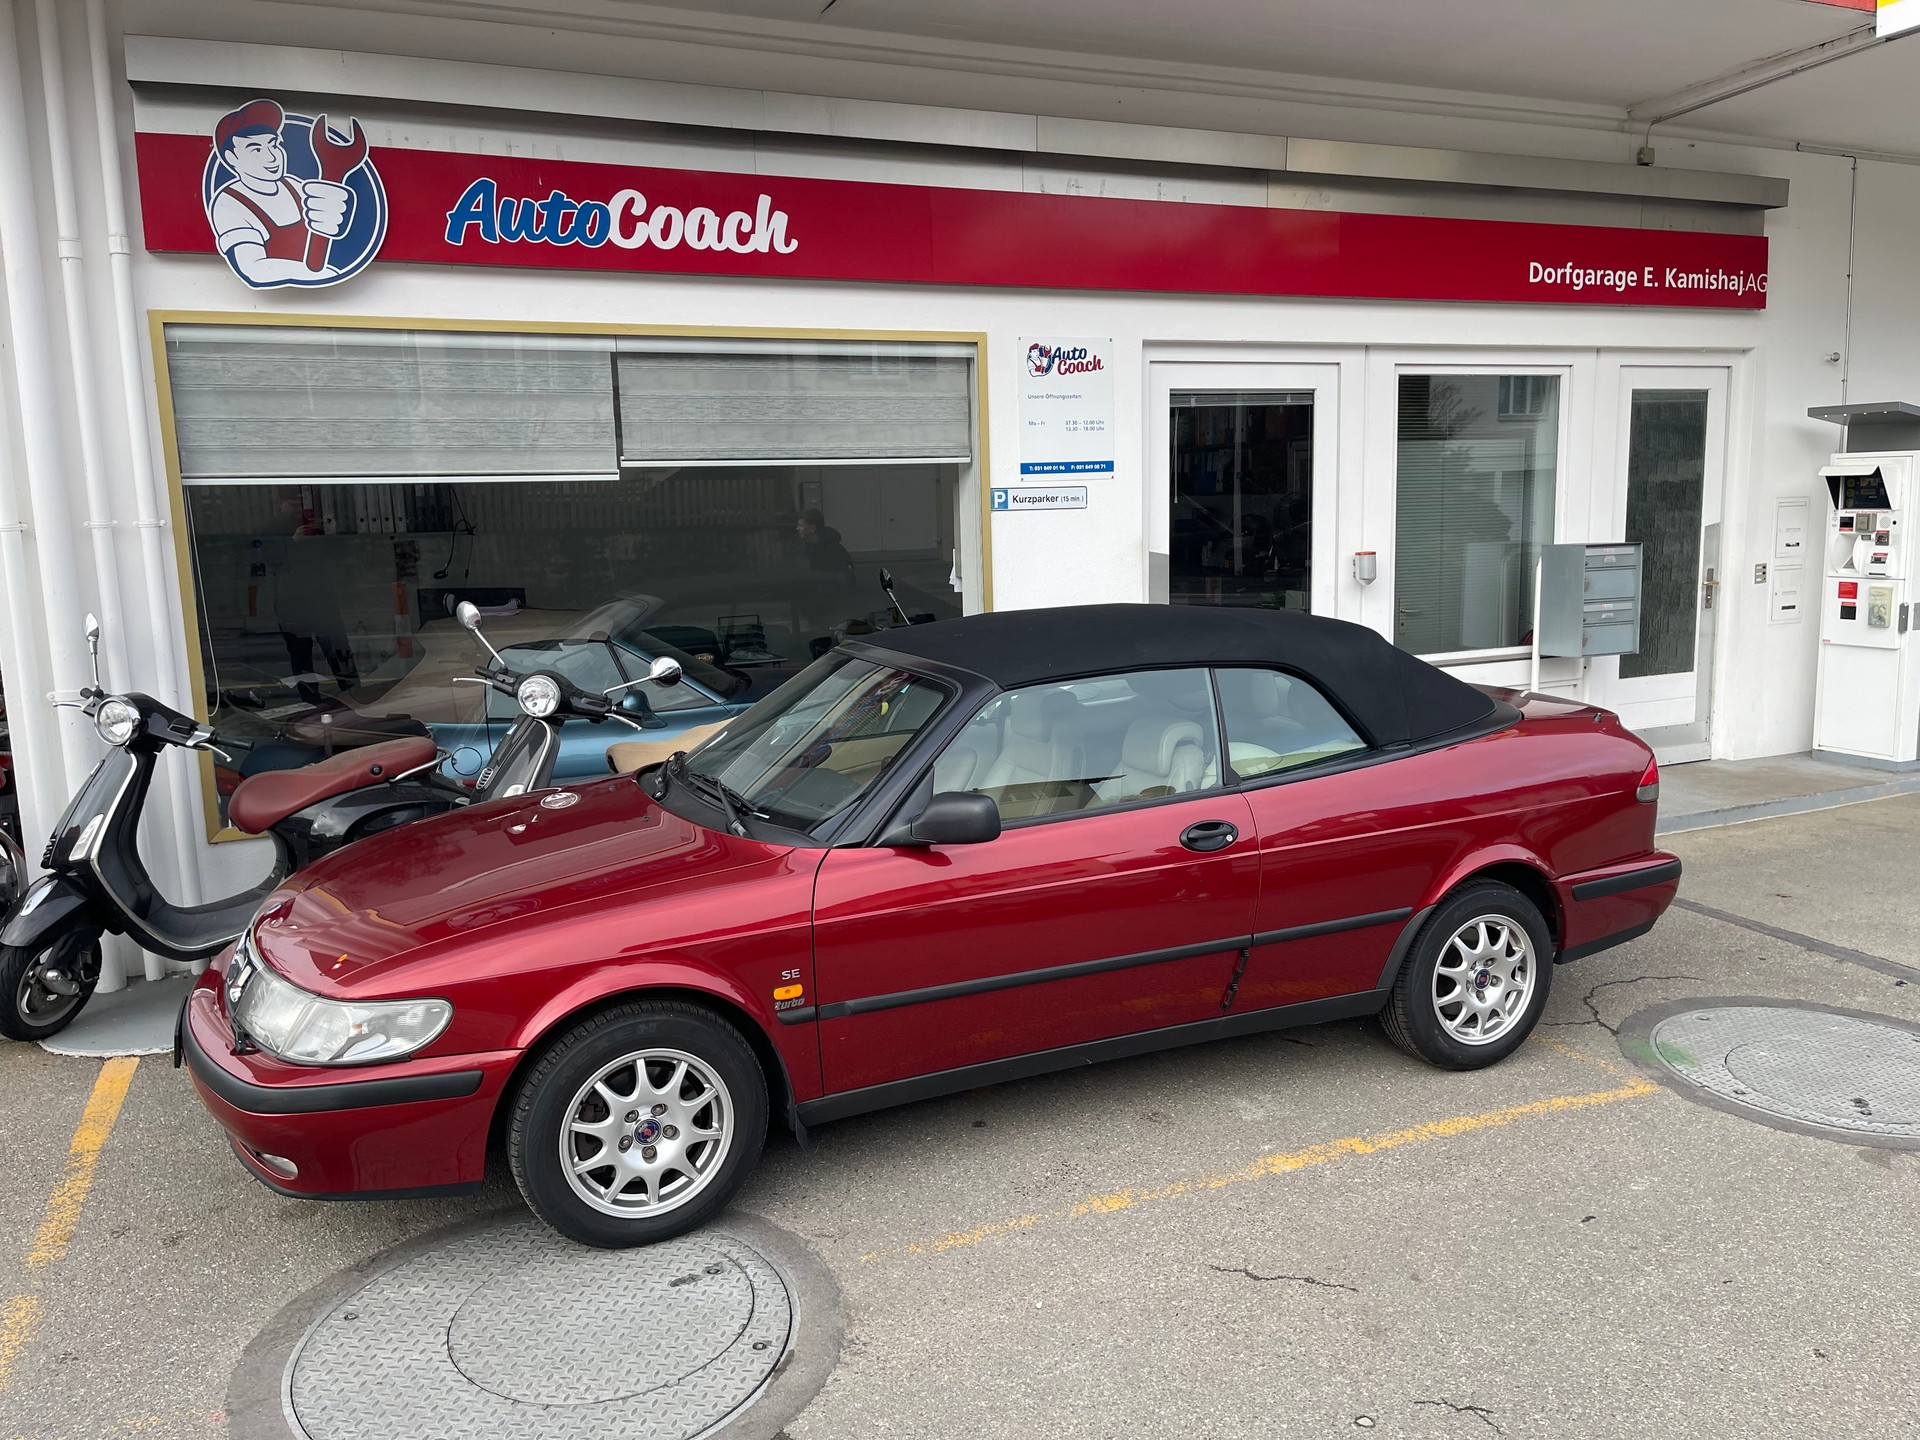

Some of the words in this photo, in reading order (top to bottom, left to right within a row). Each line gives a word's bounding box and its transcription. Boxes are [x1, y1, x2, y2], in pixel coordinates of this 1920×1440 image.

[1529, 261, 1637, 291] Dorfgarage
[1643, 266, 1659, 287] E.
[1051, 346, 1088, 364] Auto
[1057, 354, 1104, 375] Coach
[994, 491, 1006, 508] P
[1012, 495, 1059, 504] Kurzparker
[1060, 495, 1069, 503] (15
[781, 968, 801, 980] SE
